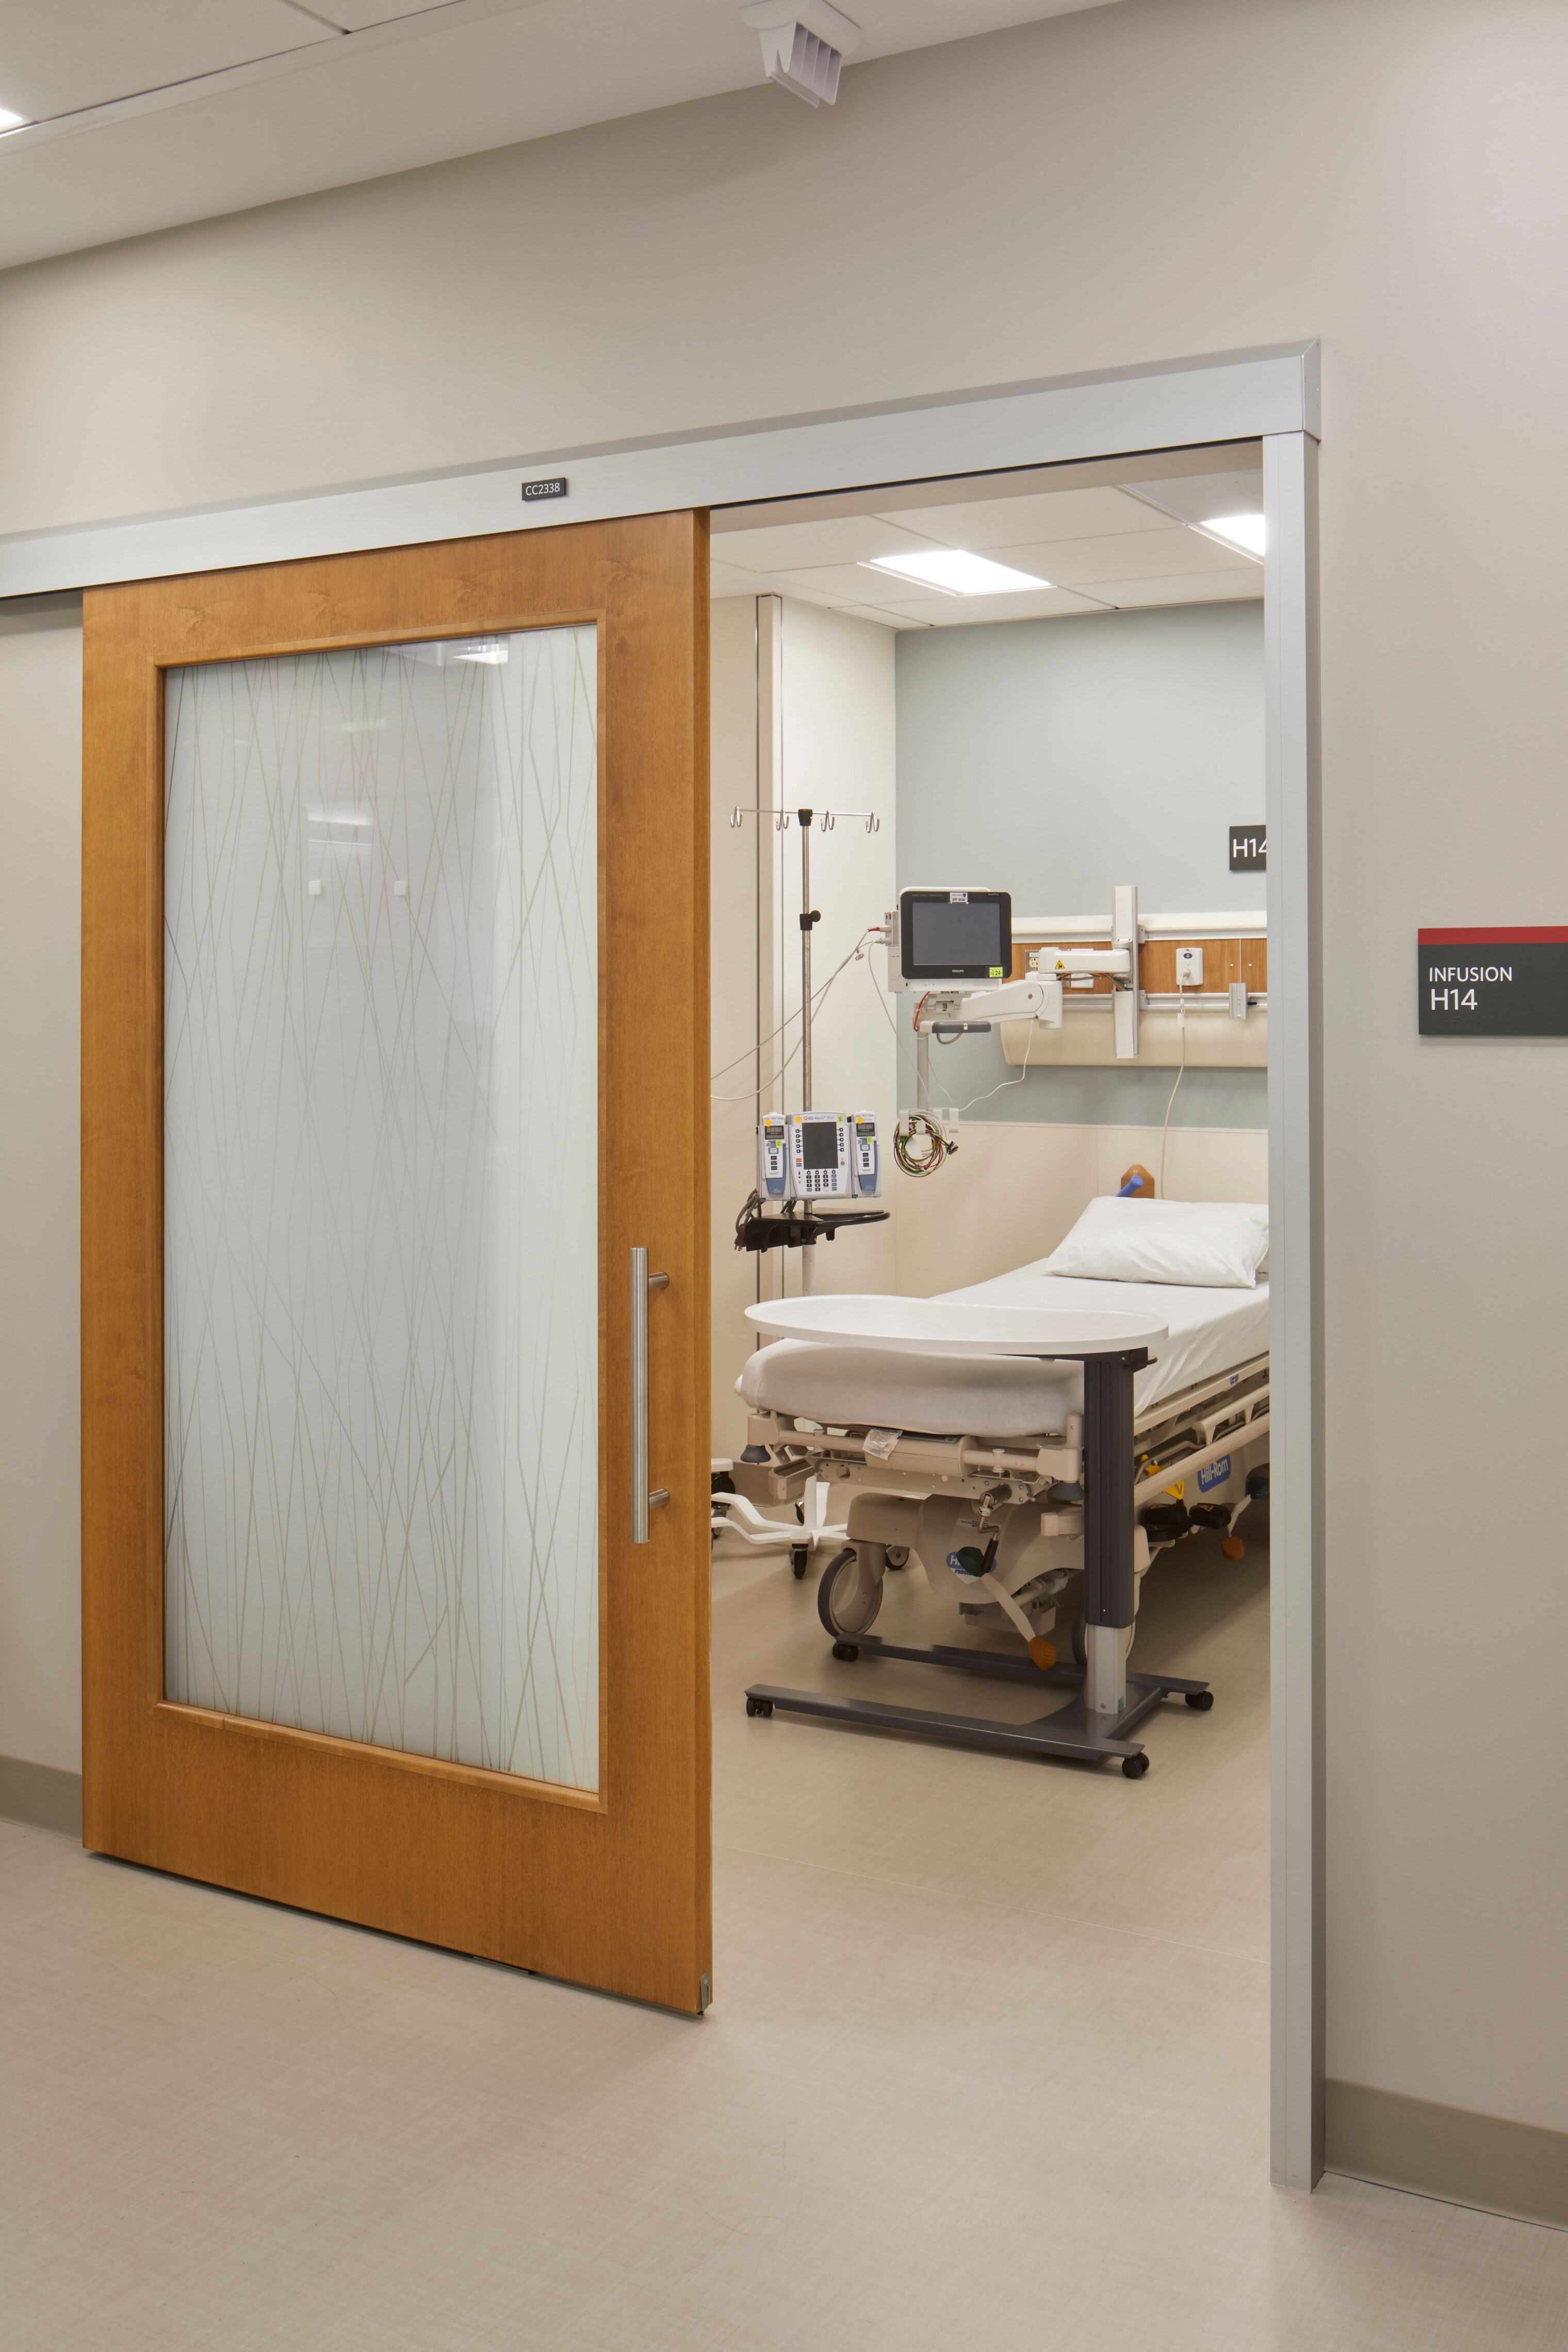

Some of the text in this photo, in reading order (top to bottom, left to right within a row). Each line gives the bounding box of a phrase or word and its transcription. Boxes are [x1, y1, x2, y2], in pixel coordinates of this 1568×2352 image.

[525, 482, 560, 496] CC2338
[1233, 838, 1267, 858] H14
[1429, 967, 1512, 982] INFUSION
[1431, 988, 1478, 1010] H14
[1201, 1459, 1229, 1485] Hill-Rom
